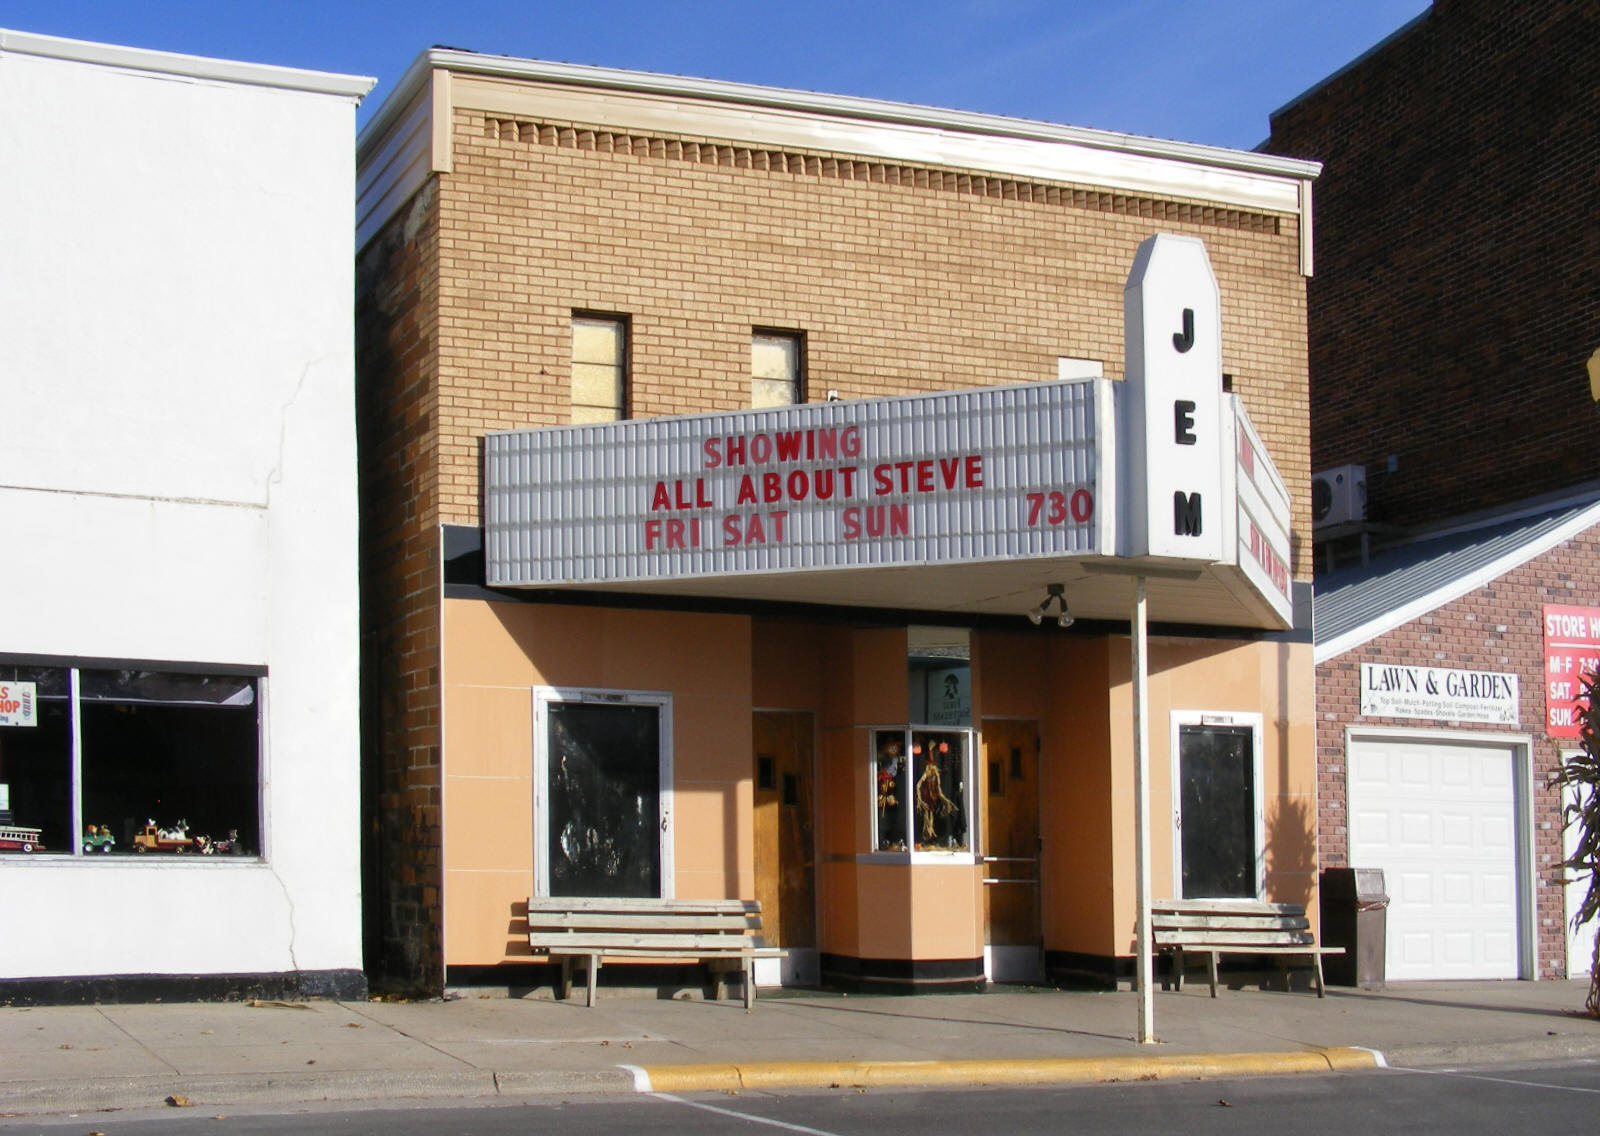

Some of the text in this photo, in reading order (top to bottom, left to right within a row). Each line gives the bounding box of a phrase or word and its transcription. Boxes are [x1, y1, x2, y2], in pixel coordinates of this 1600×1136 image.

[1172, 308, 1202, 538] JEM
[704, 427, 861, 468] SHOWING
[652, 455, 983, 511] ALL ABOUT STEVE
[645, 489, 1093, 550] FRI SAT SUN 730
[1547, 614, 1600, 639] STORE H
[1549, 656, 1573, 673] M-F
[1368, 666, 1512, 699] LAWN & GARDEN
[1550, 681, 1574, 700] SAT.
[1550, 707, 1575, 726] SUN.
